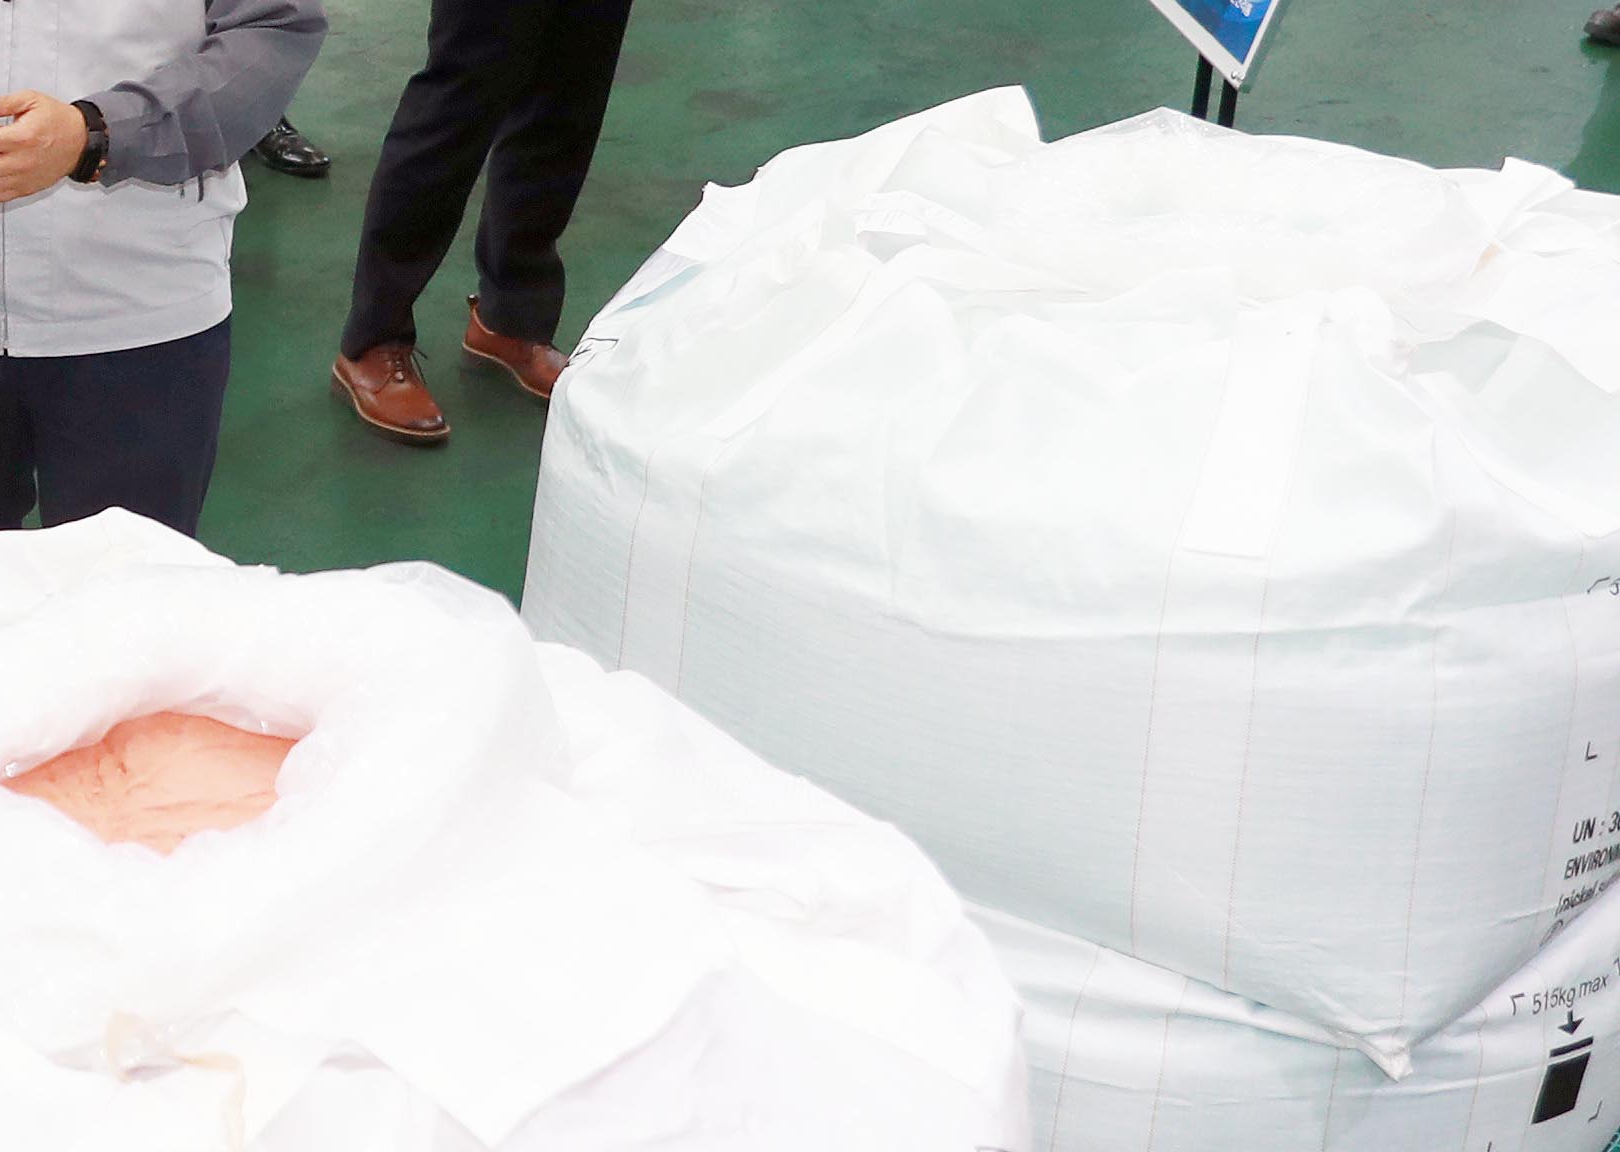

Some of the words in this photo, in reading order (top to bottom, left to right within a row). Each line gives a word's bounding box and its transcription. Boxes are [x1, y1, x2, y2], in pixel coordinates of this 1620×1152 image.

[1573, 817, 1596, 844] UN
[1532, 988, 1576, 1015] 515kg
[1579, 974, 1610, 998] max
